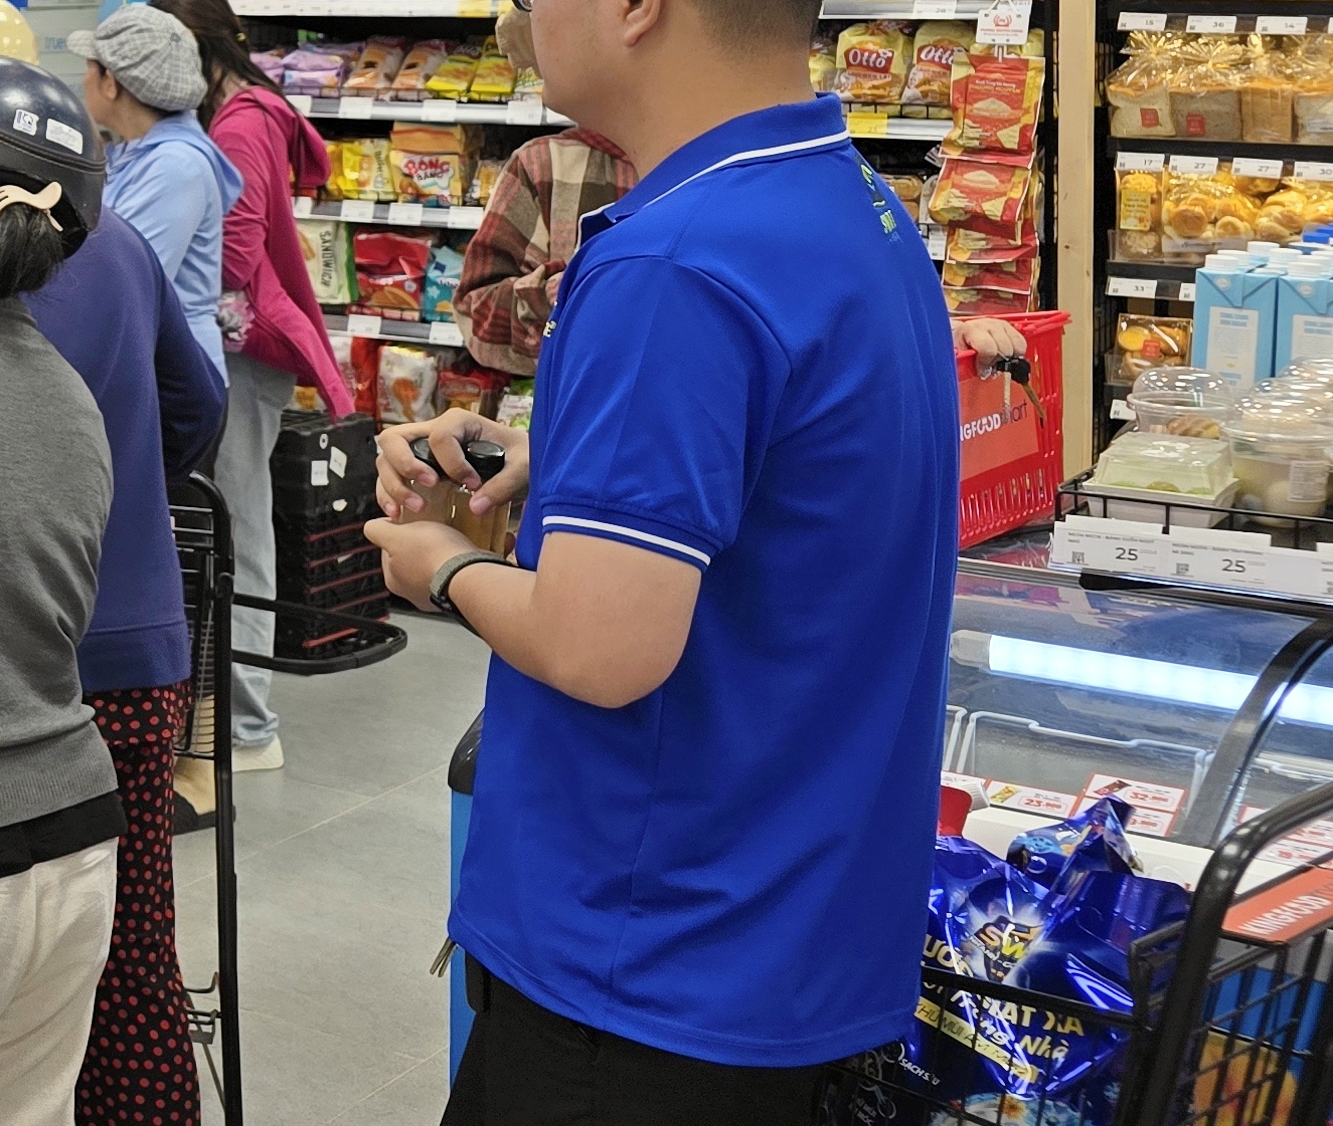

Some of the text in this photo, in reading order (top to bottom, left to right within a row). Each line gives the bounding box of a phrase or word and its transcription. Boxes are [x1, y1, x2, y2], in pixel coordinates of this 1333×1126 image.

[847, 48, 893, 69] Otto
[1193, 161, 1207, 170] 27
[1257, 165, 1271, 173] 27
[1114, 546, 1140, 561] 25
[1221, 558, 1247, 573] 25
